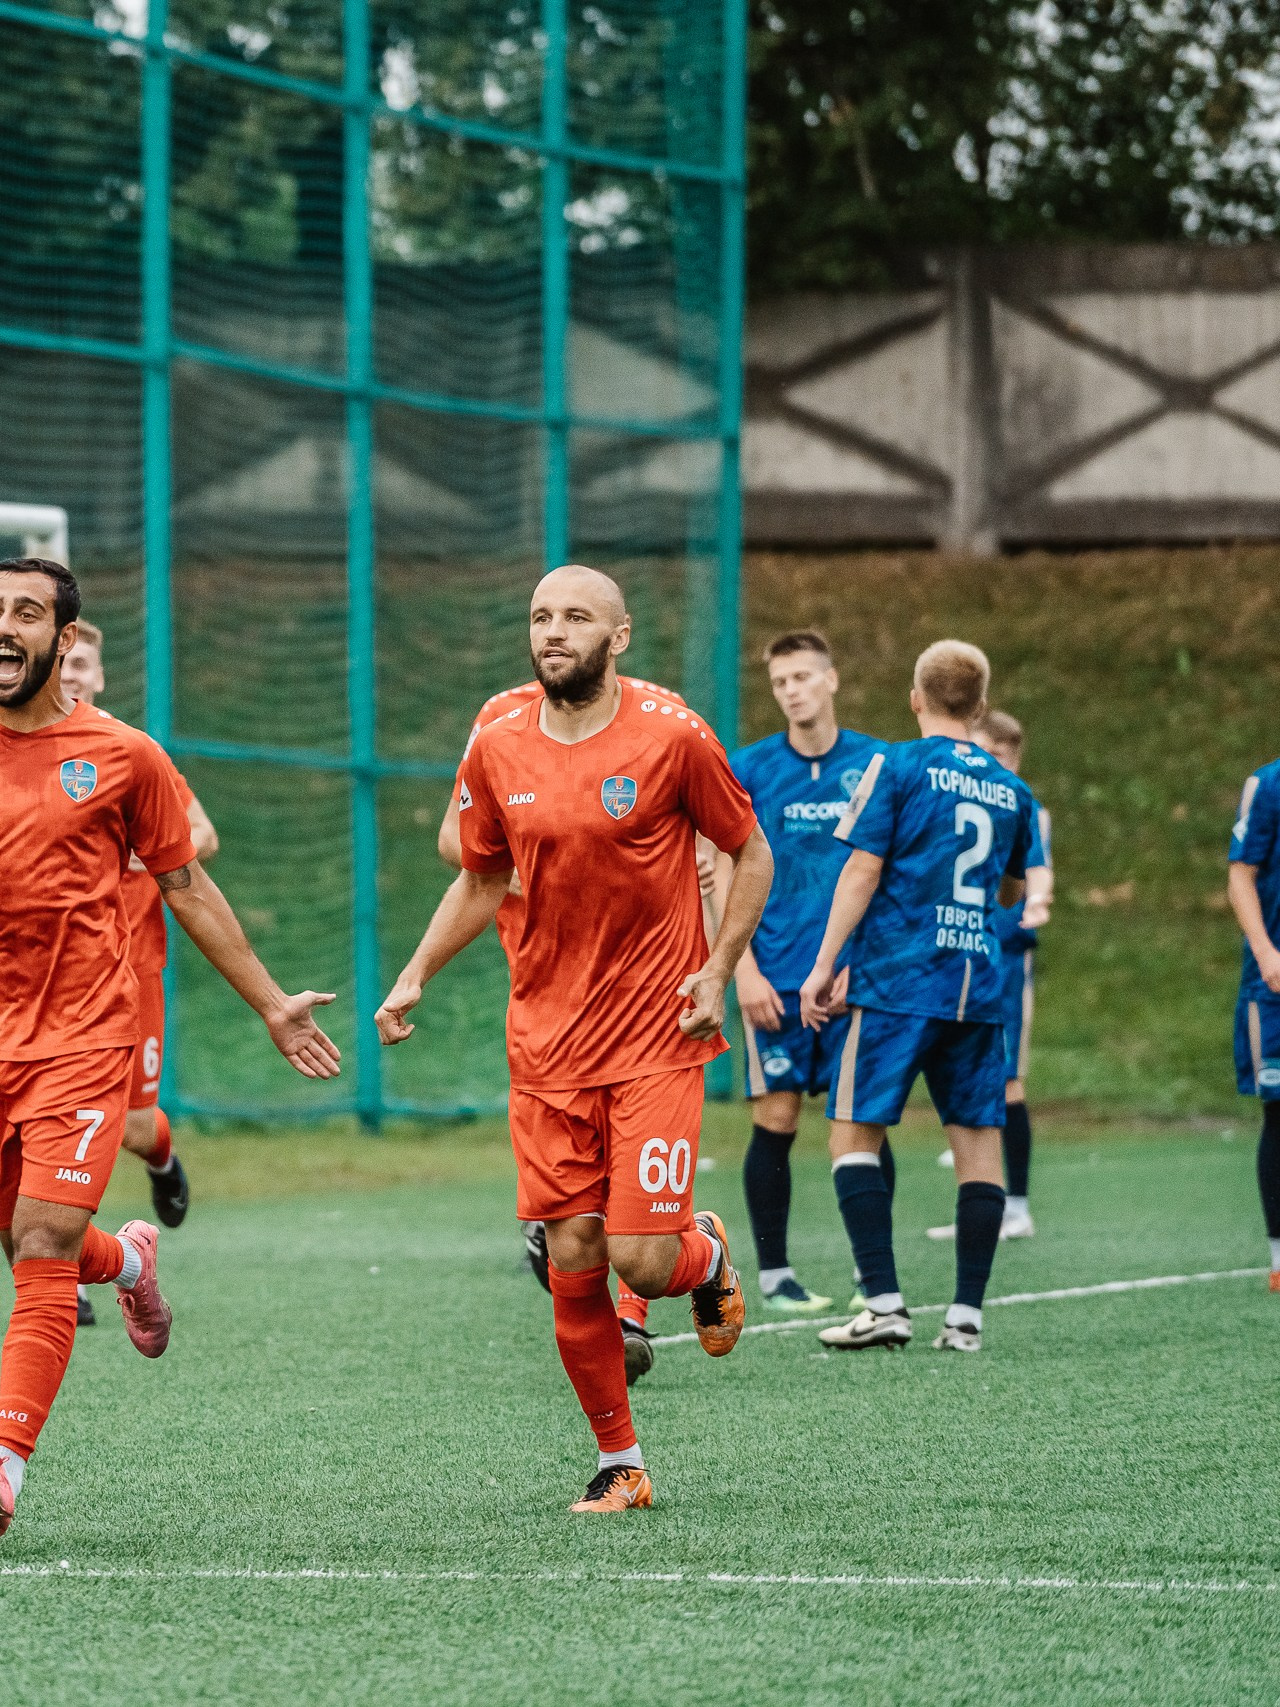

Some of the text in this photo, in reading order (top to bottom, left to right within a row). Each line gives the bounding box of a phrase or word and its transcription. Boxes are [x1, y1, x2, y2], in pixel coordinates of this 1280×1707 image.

[507, 792, 535, 806] JAKO
[926, 766, 1017, 812] ТОРМАШЕВ
[952, 801, 994, 907] 2
[142, 1036, 159, 1079] 6
[74, 1109, 105, 1162] 7
[55, 1167, 91, 1185] JAKO
[638, 1137, 691, 1195] 60
[649, 1201, 681, 1213] JAKO
